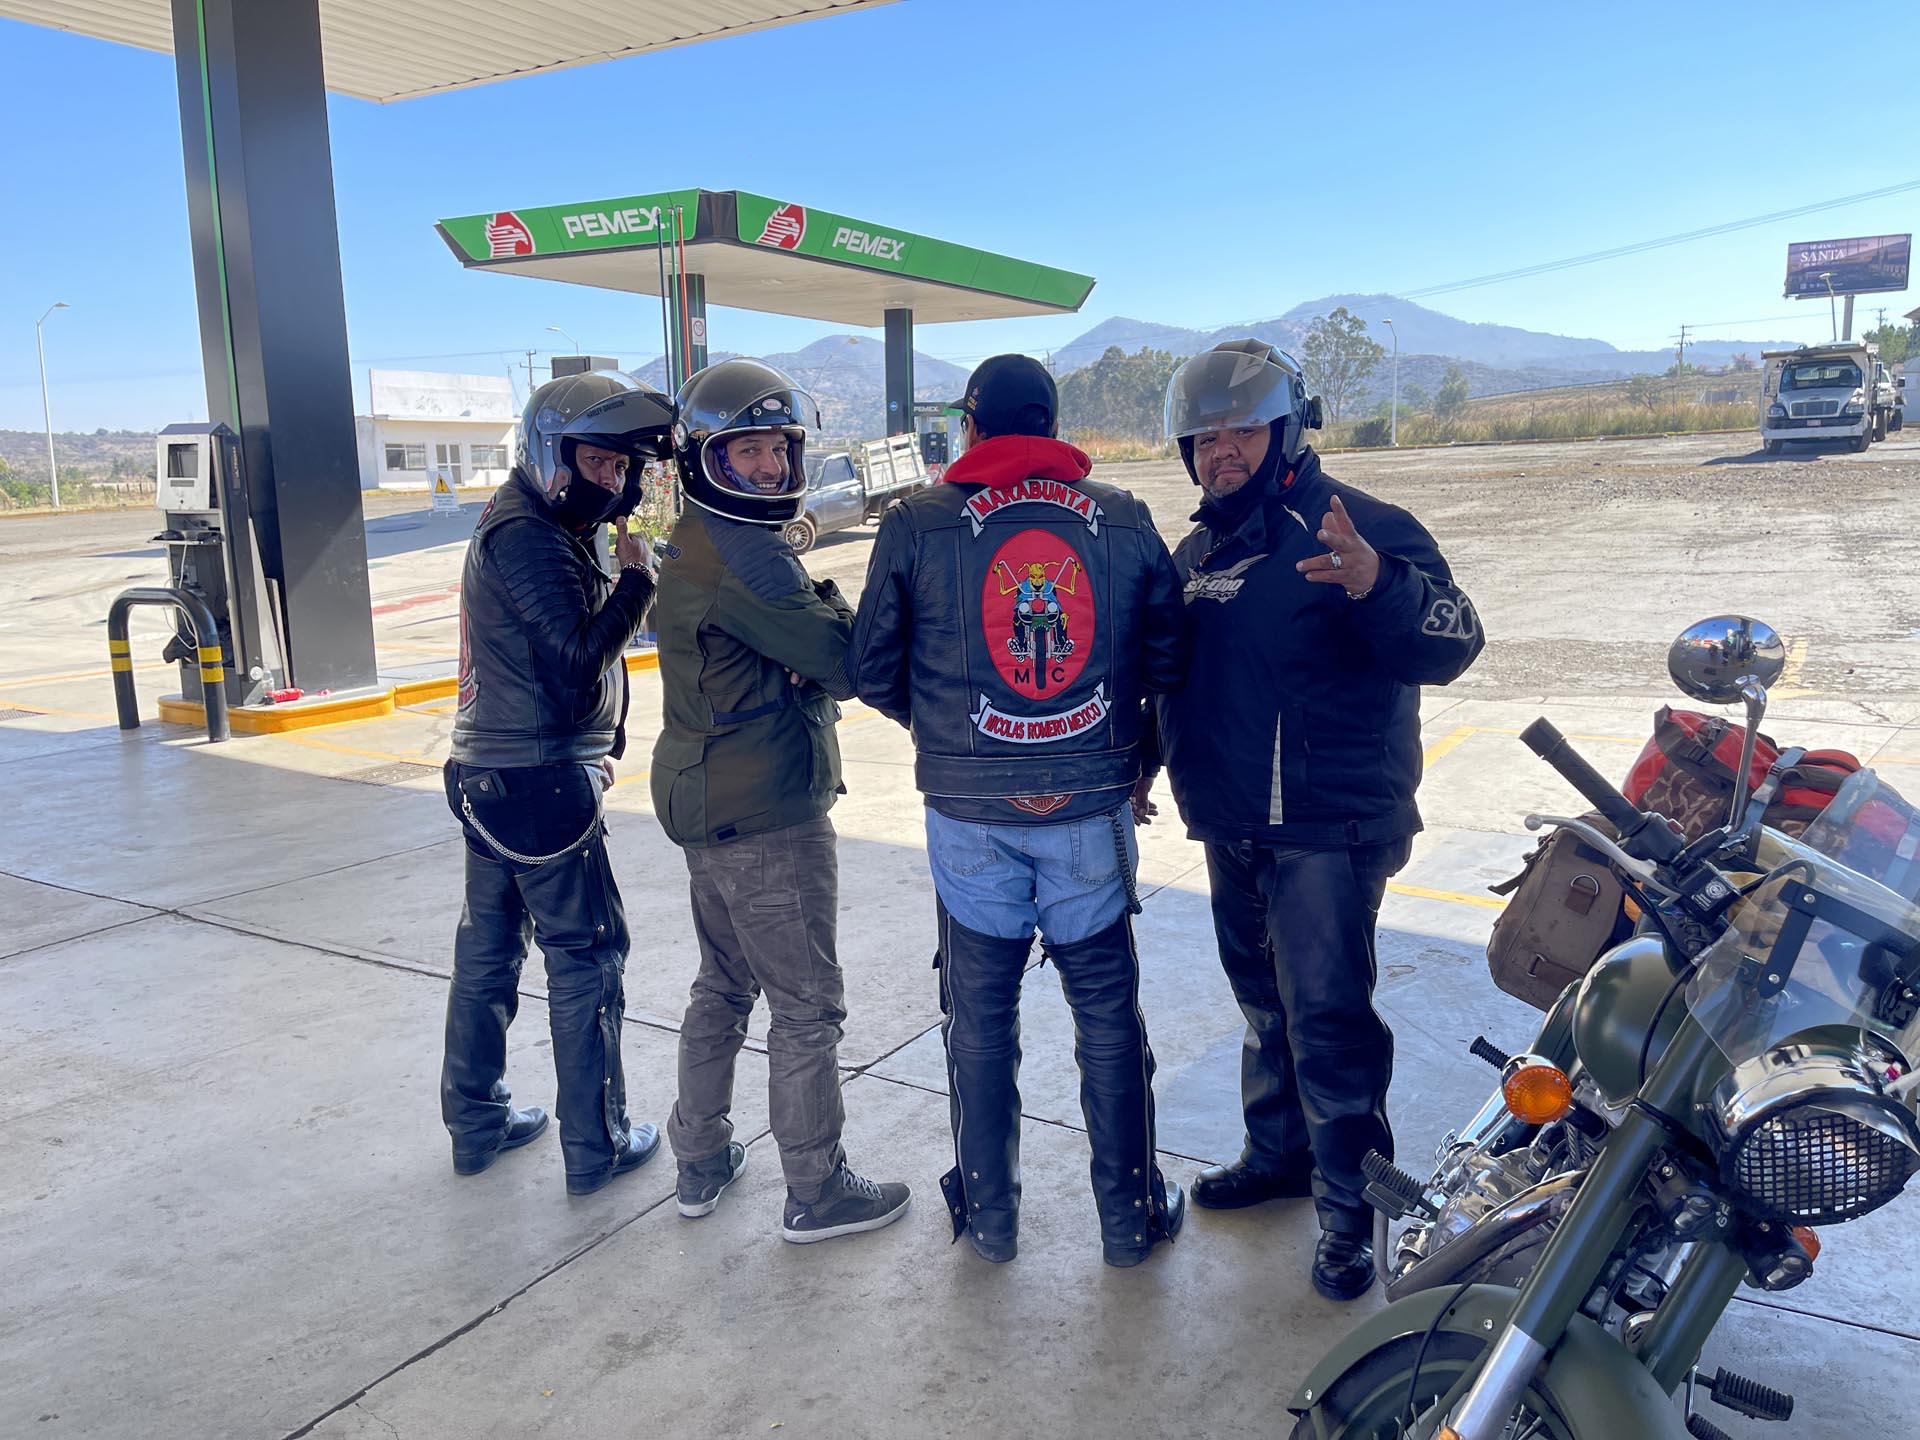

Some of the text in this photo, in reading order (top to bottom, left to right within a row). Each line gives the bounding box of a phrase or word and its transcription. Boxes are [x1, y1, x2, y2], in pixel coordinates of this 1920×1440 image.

[562, 206, 666, 239] PEMEX
[832, 227, 905, 261] PEMEX
[1800, 249, 1846, 263] SANTA
[913, 405, 940, 413] PEMEX
[968, 481, 1092, 518] MARABUNTA
[1014, 667, 1065, 684] M C
[983, 702, 1102, 740] NICOLAS ROMERO MEXICO
